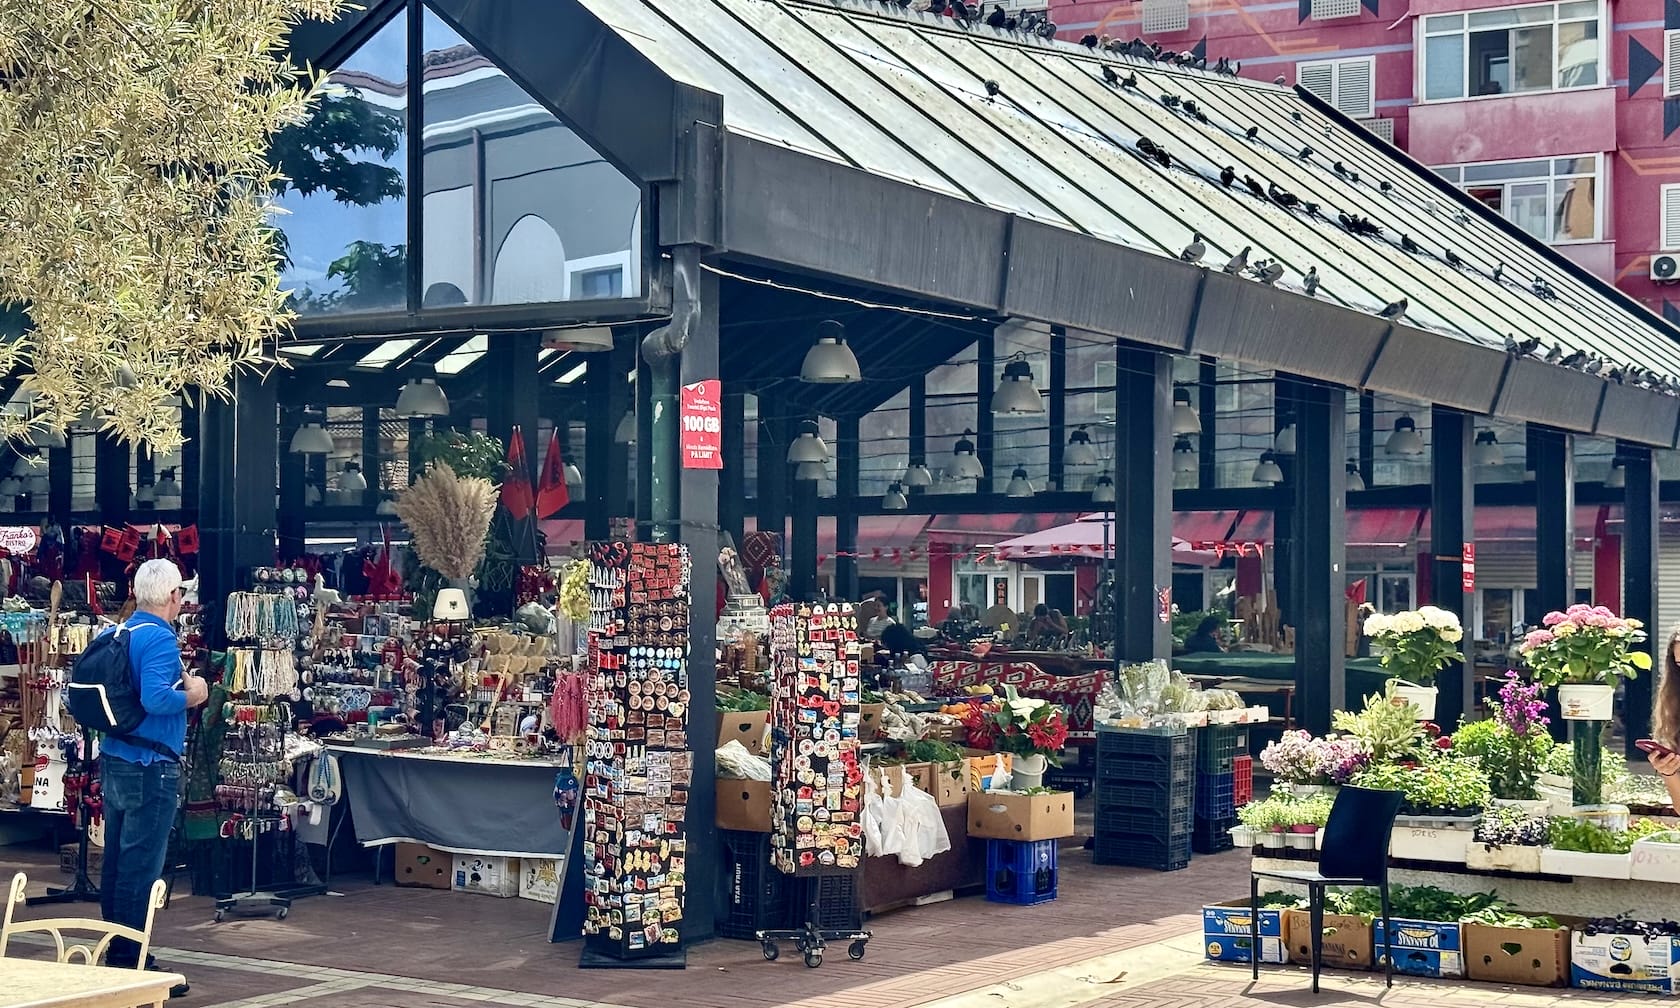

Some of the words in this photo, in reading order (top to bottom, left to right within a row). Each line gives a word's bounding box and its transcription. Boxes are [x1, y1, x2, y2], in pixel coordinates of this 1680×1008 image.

[683, 416, 703, 432] 100
[704, 416, 720, 432] GB
[690, 450, 698, 459] PA
[699, 450, 713, 459] LIMIT
[1223, 919, 1250, 934] BANANAS
[1398, 930, 1428, 947] BANANAS
[1322, 942, 1345, 954] ANANAS
[1580, 979, 1621, 988] BANANAS
[1622, 982, 1664, 991] PREMIUM
